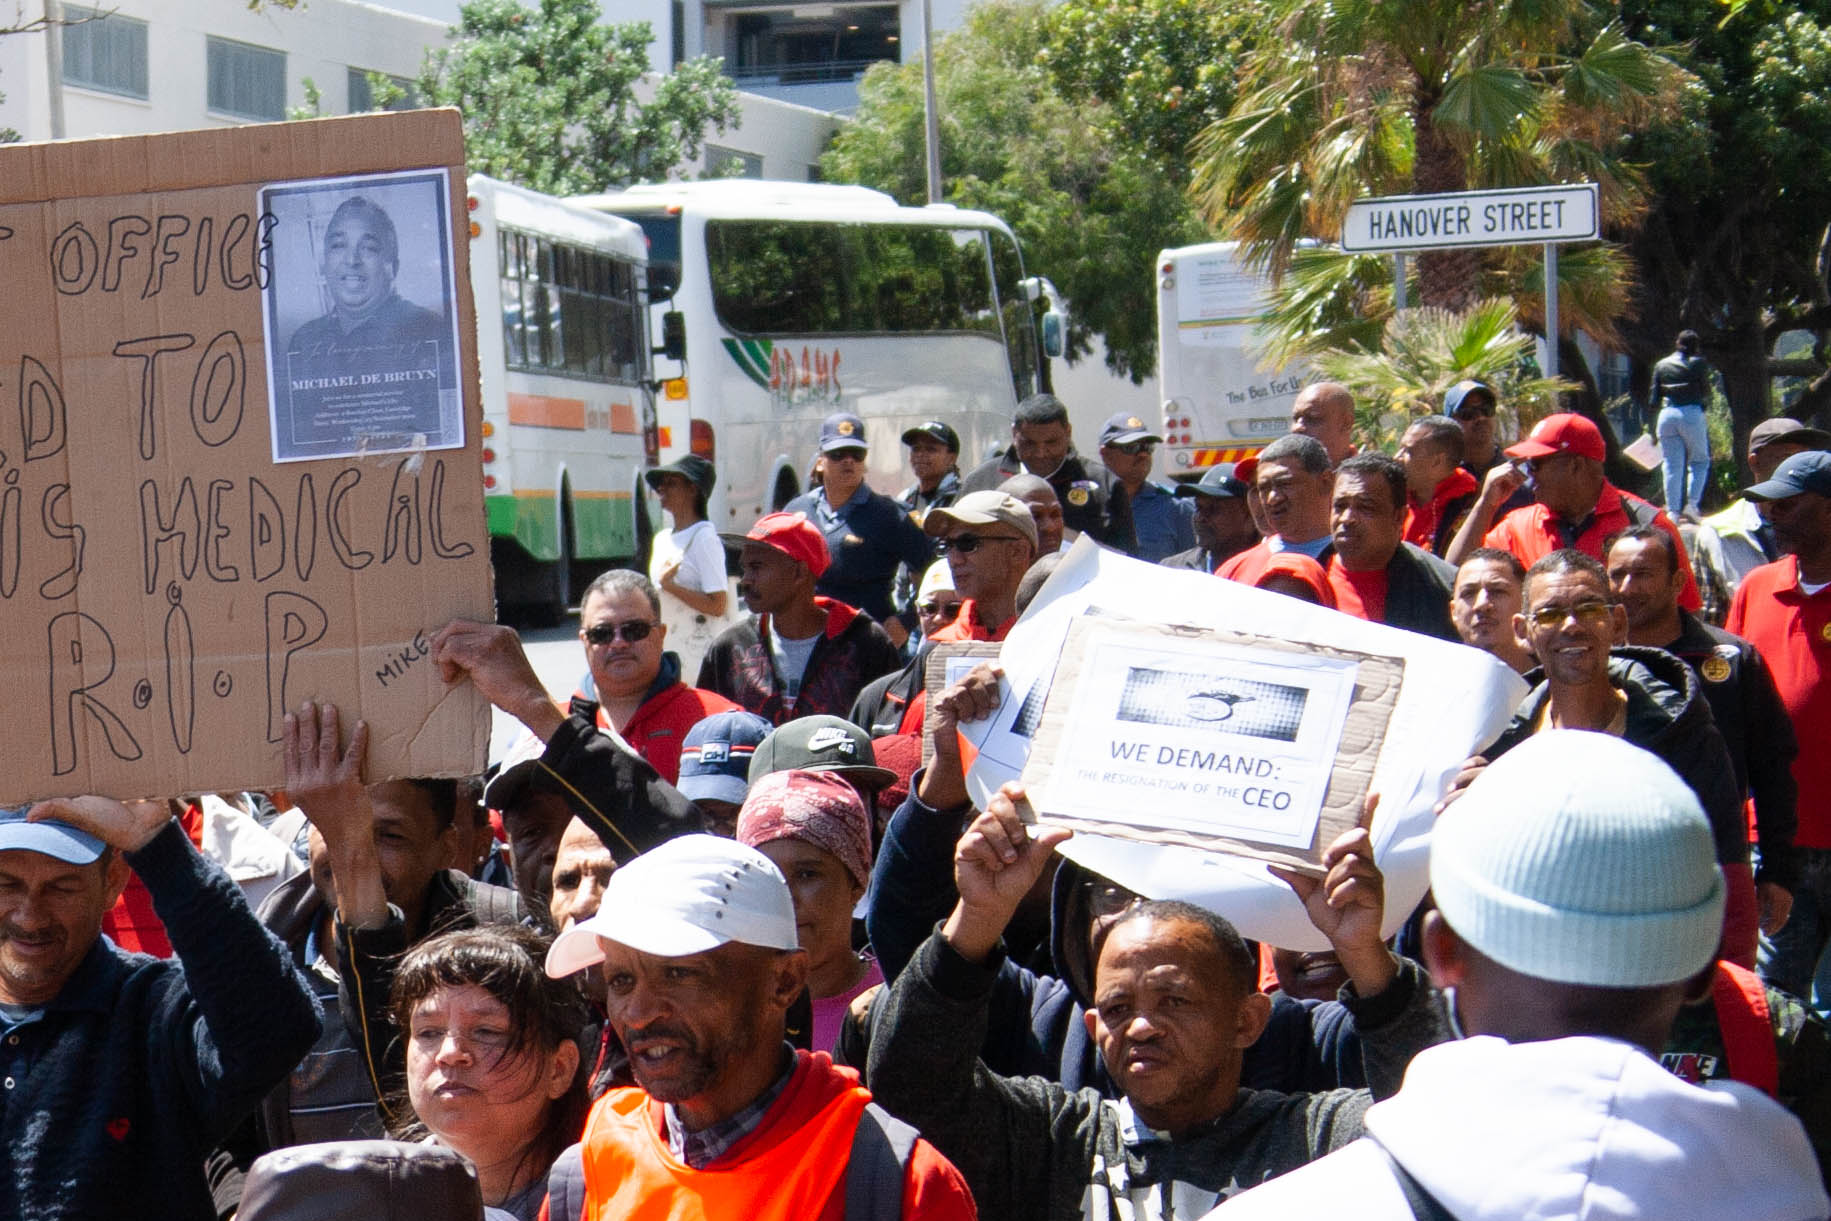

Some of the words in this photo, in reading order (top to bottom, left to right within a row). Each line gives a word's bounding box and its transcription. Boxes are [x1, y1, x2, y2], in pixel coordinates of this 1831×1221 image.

[1370, 205, 1471, 240] HANOVER
[1484, 200, 1567, 233] STREET
[51, 213, 280, 300] OFFICE
[112, 330, 247, 460] TO
[292, 375, 358, 391] MICHAEL
[361, 373, 381, 386] DE
[385, 369, 437, 383] BRUYN
[1226, 391, 1245, 404] The
[1248, 385, 1268, 399] Bus
[1270, 380, 1288, 395] For
[141, 459, 475, 597] MEDICAL
[1111, 740, 1151, 763] WE
[1157, 746, 1281, 780] DEMAND:
[1078, 769, 1098, 782] THE
[1102, 771, 1188, 792] RESIGNATION
[1193, 782, 1210, 794] OF
[1217, 785, 1241, 799] THE
[1242, 786, 1292, 811] CEO
